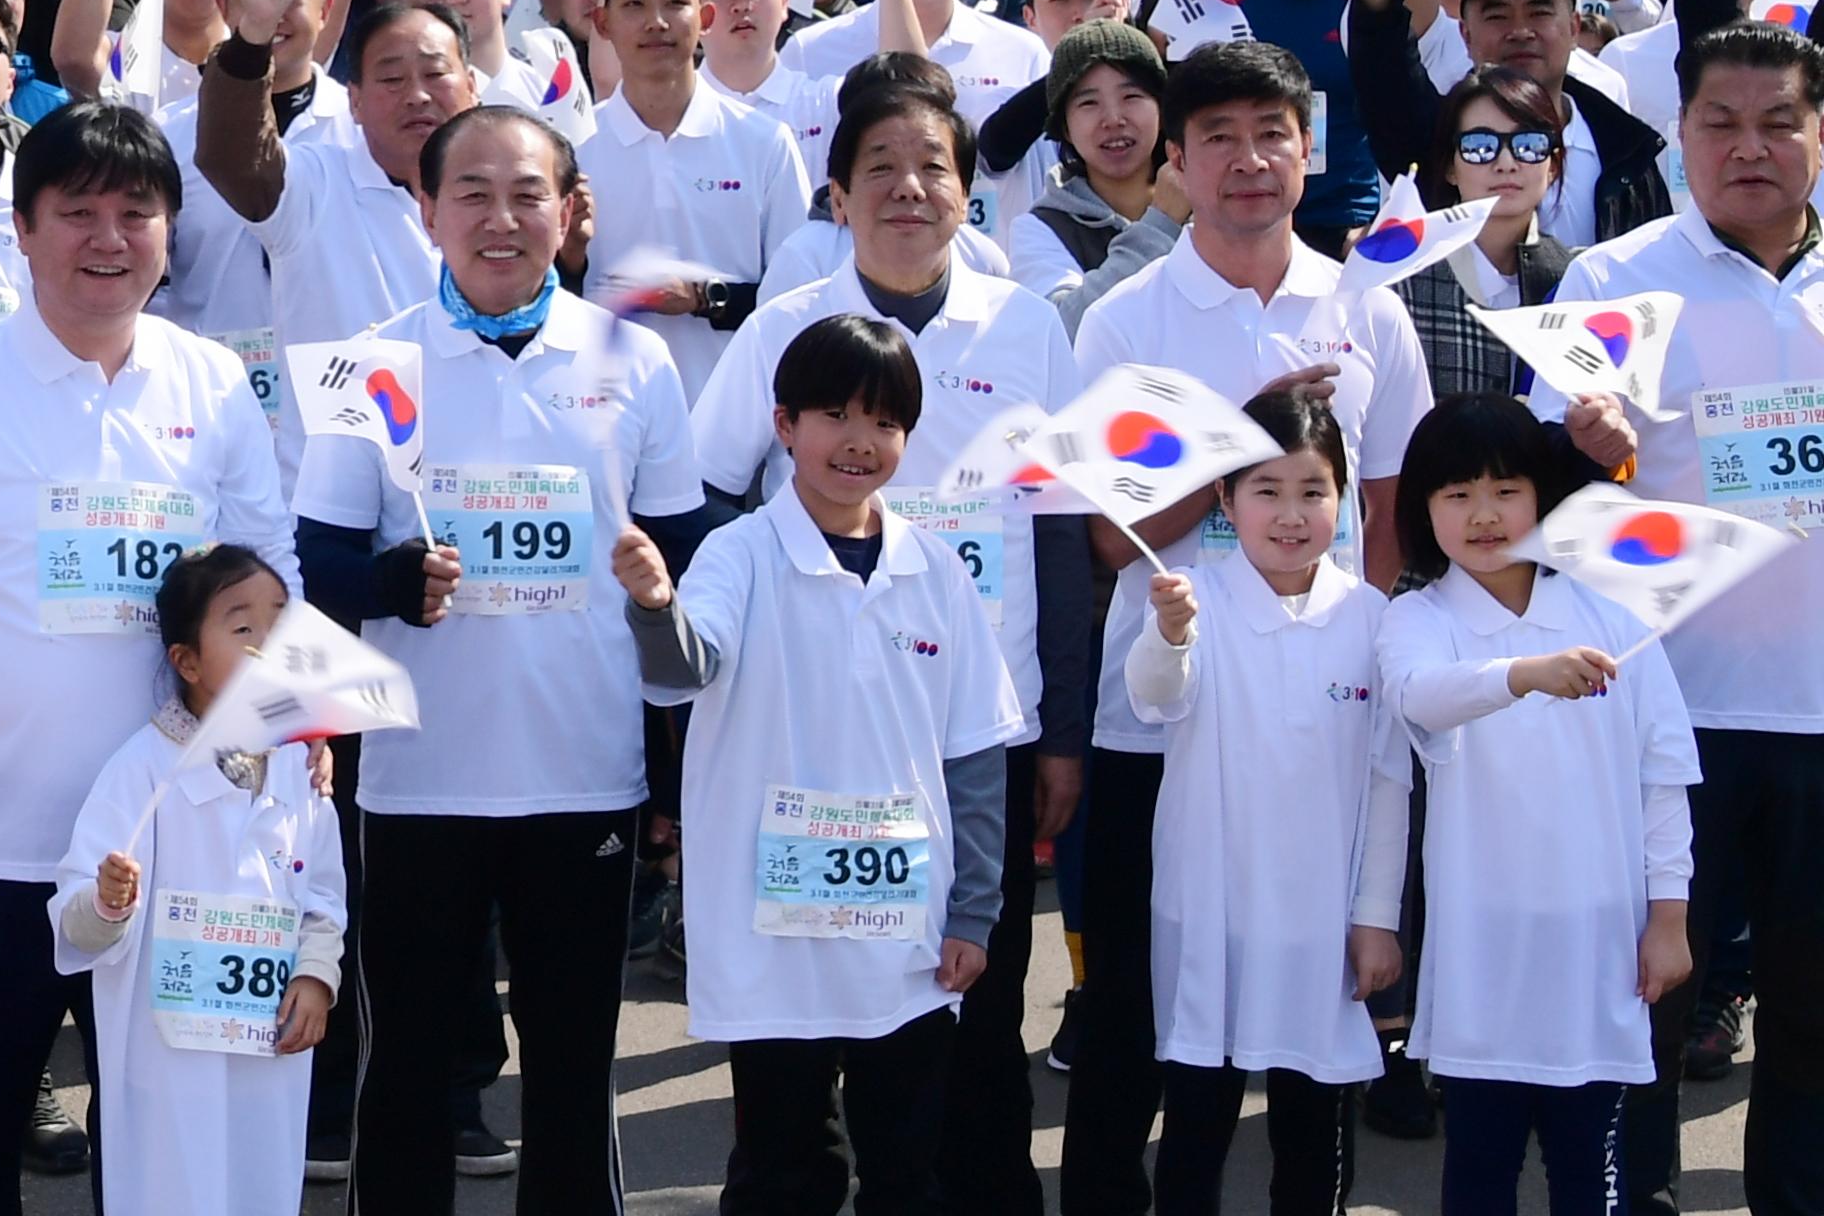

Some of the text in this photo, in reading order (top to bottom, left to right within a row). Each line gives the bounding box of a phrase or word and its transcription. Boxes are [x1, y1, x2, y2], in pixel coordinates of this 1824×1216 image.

[1705, 402, 1735, 419] 홍천
[1742, 411, 1796, 430] 성공개최
[432, 478, 580, 495] 홍천 강원도민체육대회
[50, 497, 79, 513] 홍천
[85, 495, 195, 518] 강원도민체육대회
[462, 494, 548, 510] 성공개최 기원
[84, 510, 166, 530] 성공개최 기원
[482, 520, 572, 561] 199
[957, 540, 984, 579] 6
[514, 585, 567, 605] high1
[774, 801, 803, 818] 홍천
[807, 821, 862, 839] 성공개최
[822, 845, 910, 886] 390
[168, 905, 197, 922] 홍천
[854, 910, 904, 930] high1
[201, 925, 257, 944] 성공개최
[215, 954, 290, 999] 389
